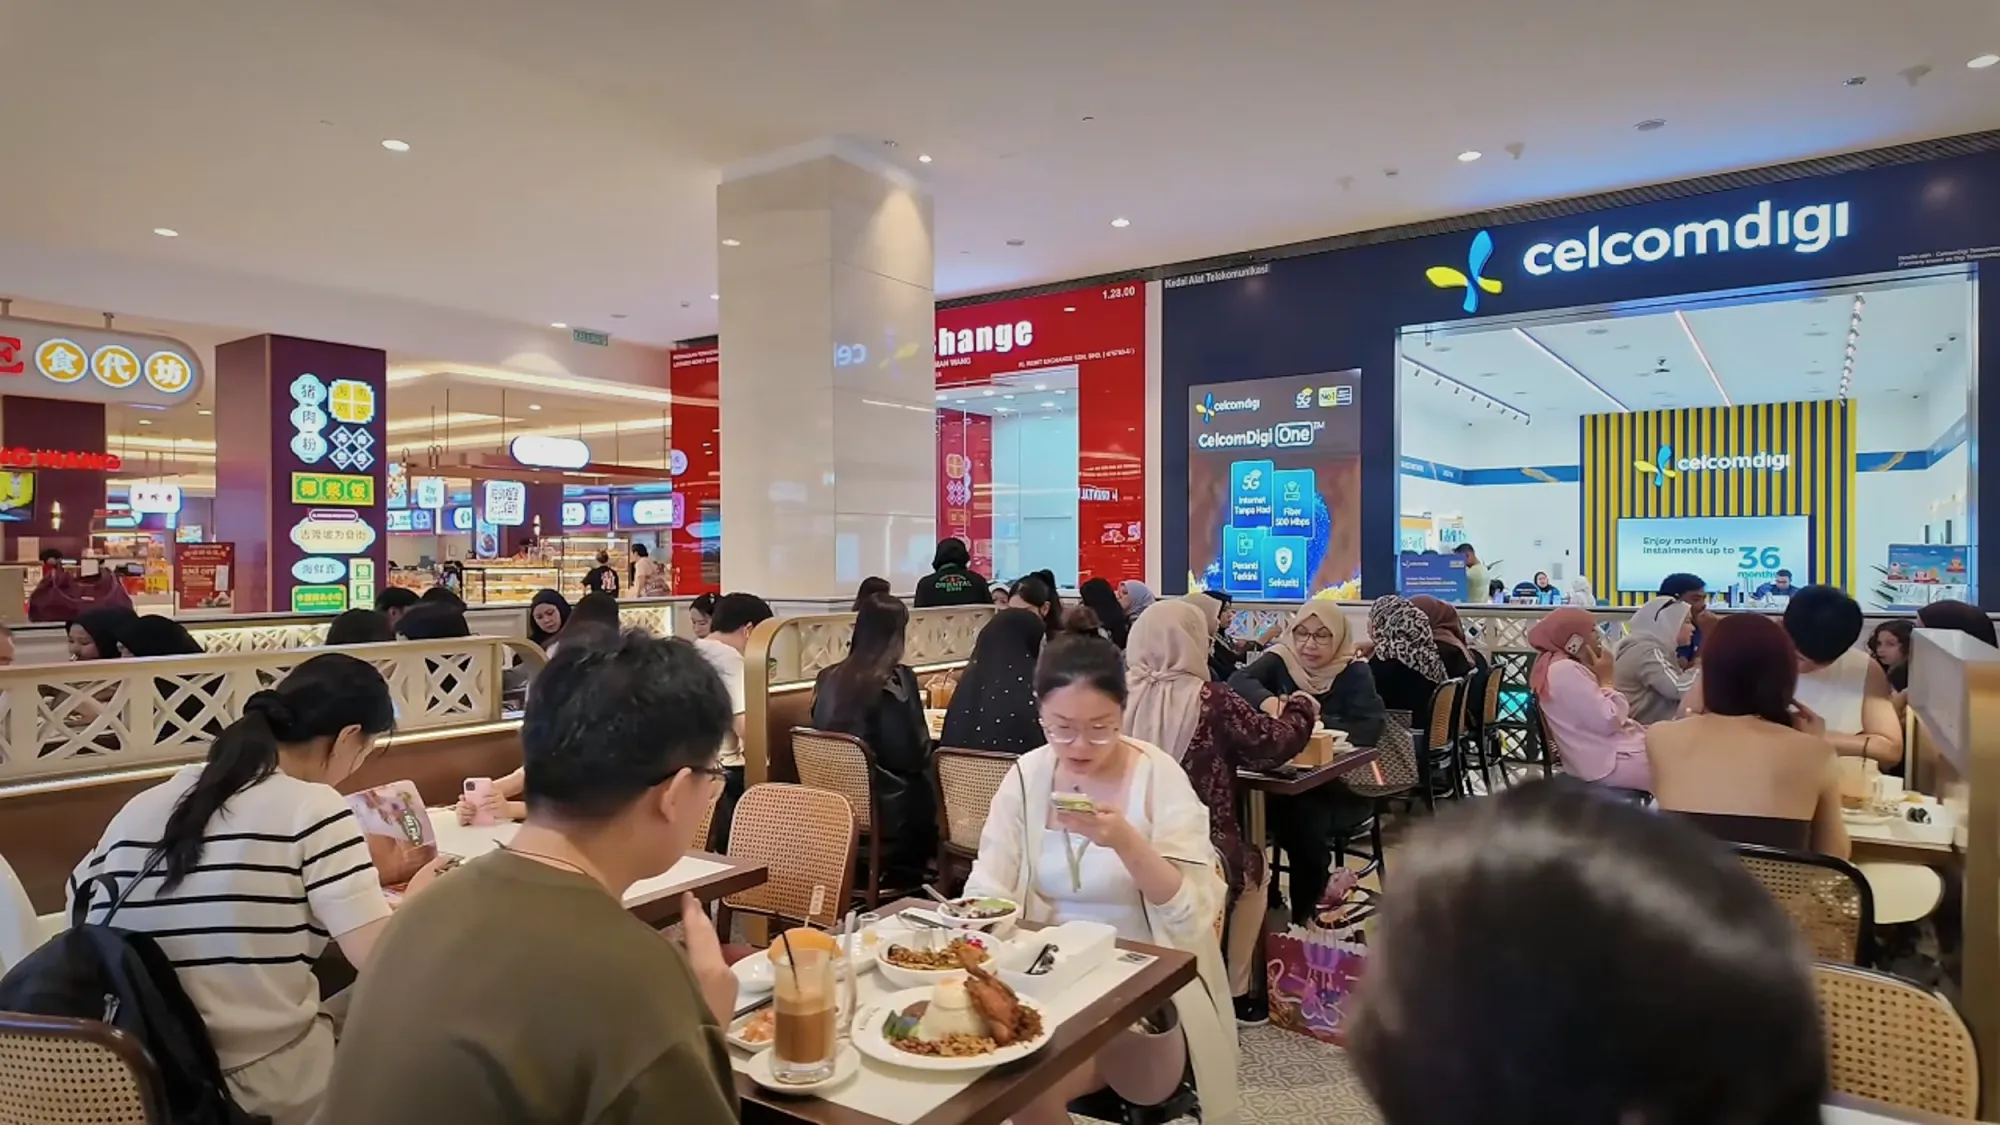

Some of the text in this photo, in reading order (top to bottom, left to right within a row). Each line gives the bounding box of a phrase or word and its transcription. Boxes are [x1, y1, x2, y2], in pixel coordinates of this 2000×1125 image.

[1522, 200, 1849, 276] celcomdigi
[1164, 264, 1269, 288] Kedai Alat Telekomunikasi
[934, 320, 1033, 356] hange
[46, 346, 184, 386] 食代坊
[1214, 397, 1260, 412] celcomdigi
[1198, 428, 1273, 448] CelcomDigi
[1279, 426, 1309, 442] One
[1677, 451, 1790, 471] celcomdigi
[1643, 536, 1718, 546] Enjoy monthly
[1738, 546, 1781, 569] 36
